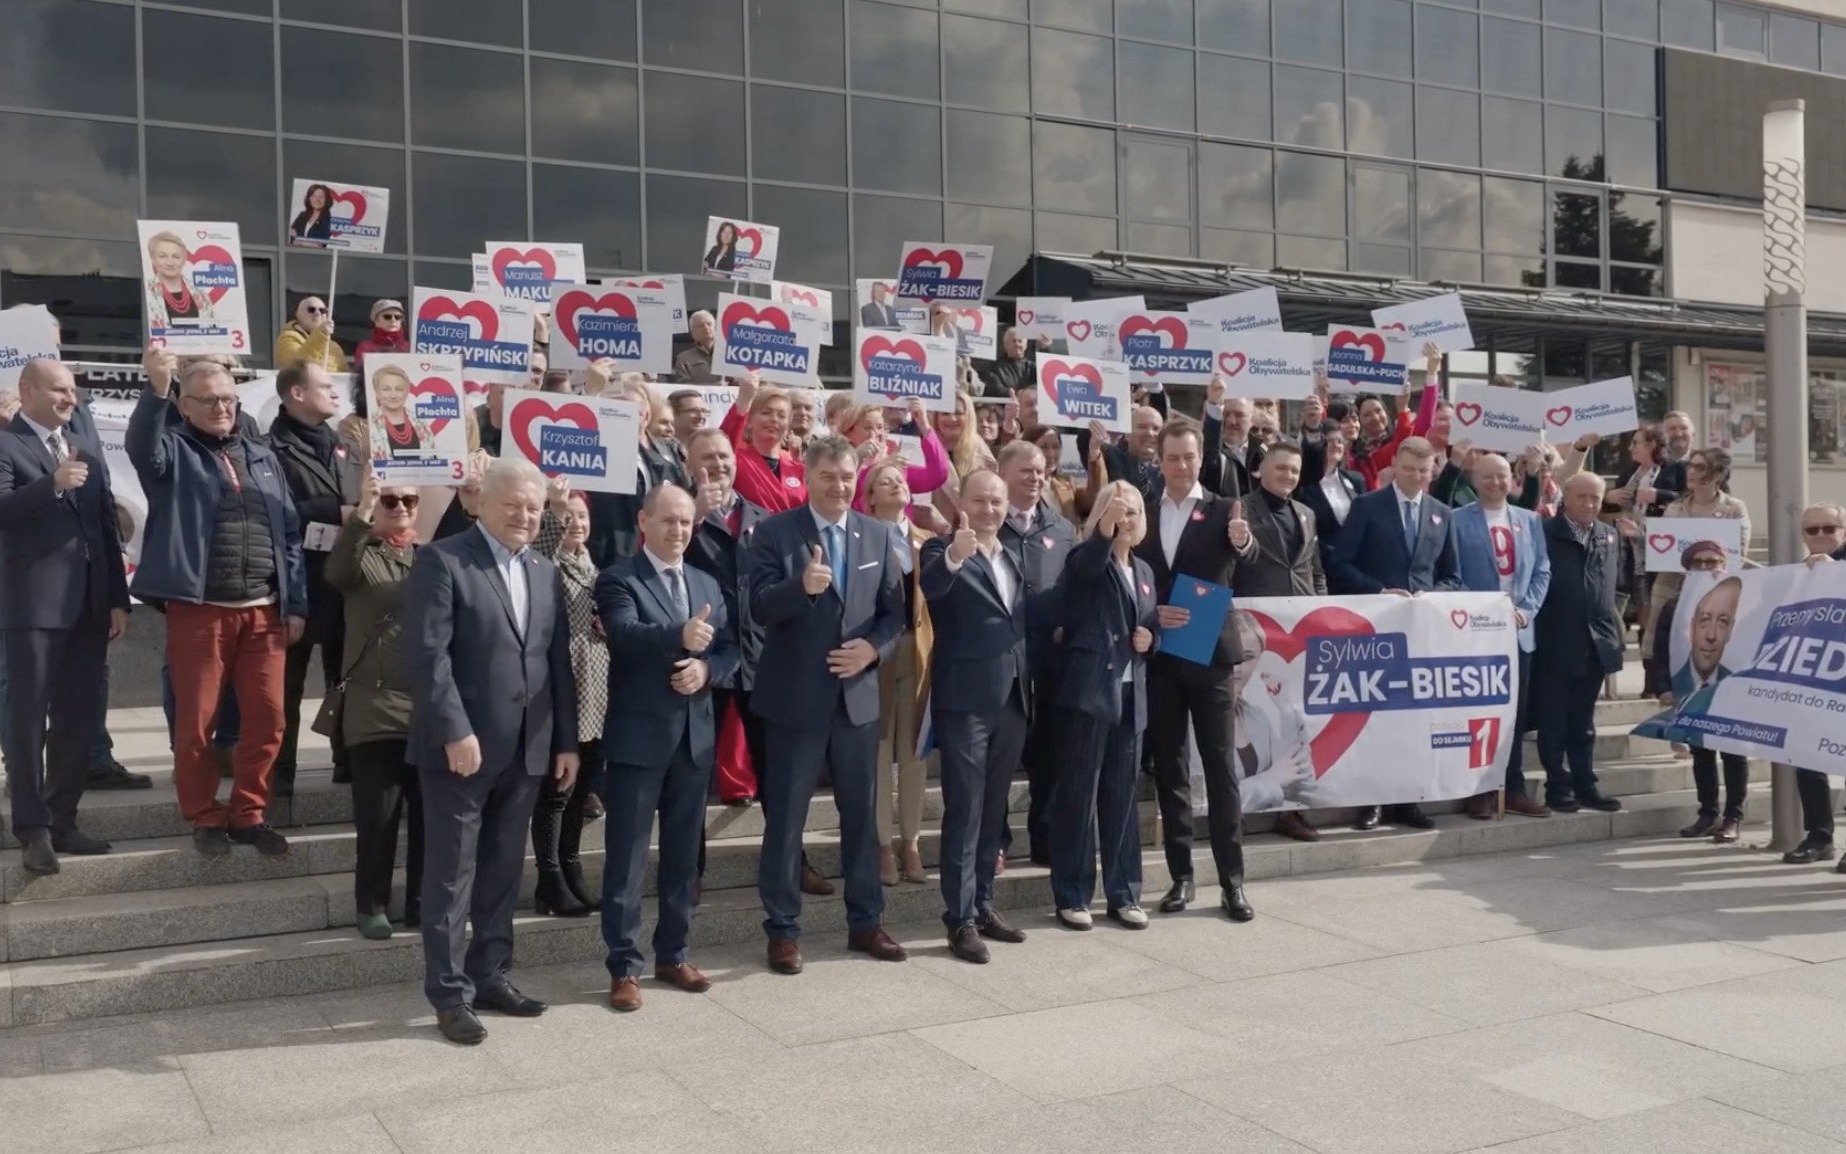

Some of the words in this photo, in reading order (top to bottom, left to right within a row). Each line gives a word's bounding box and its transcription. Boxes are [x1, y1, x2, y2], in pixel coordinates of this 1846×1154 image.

[505, 269, 544, 281] Mariusz
[906, 267, 937, 279] Sylwia
[901, 280, 980, 297] ŻAK-BIESIK
[418, 323, 470, 342] Andrzej
[579, 318, 638, 332] Kazimierz
[231, 330, 245, 348] 3
[580, 338, 641, 355] HOMA
[1128, 337, 1153, 348] Piotr
[727, 345, 806, 370] KOTAPKA
[1124, 353, 1212, 371] KASPRZYK
[1248, 358, 1287, 368] Koalicja
[1331, 349, 1363, 361] Joanna
[869, 358, 922, 374] Katarzyna
[1248, 366, 1311, 377] Obywatelska
[870, 373, 941, 396] BLIŹNIAK
[1066, 384, 1088, 396] Ewa
[1065, 400, 1112, 417] WITEK
[1483, 410, 1520, 423] Koalicja
[1575, 403, 1610, 415] Koalicja
[1575, 406, 1633, 421] Obywatelska
[1483, 419, 1541, 433] Obywatelska
[543, 430, 599, 446] Krzysztof
[542, 449, 605, 470] KANIA
[451, 460, 465, 480] 3
[1490, 525, 1516, 576] 9
[1319, 637, 1395, 669] Sylwia
[1307, 663, 1508, 706] ŻAK-BIESIK
[1748, 684, 1803, 704] kandydat
[1804, 694, 1824, 709] do
[1692, 719, 1730, 735] naszego
[1731, 724, 1780, 743] Powiatu!
[1476, 720, 1492, 766] 1
